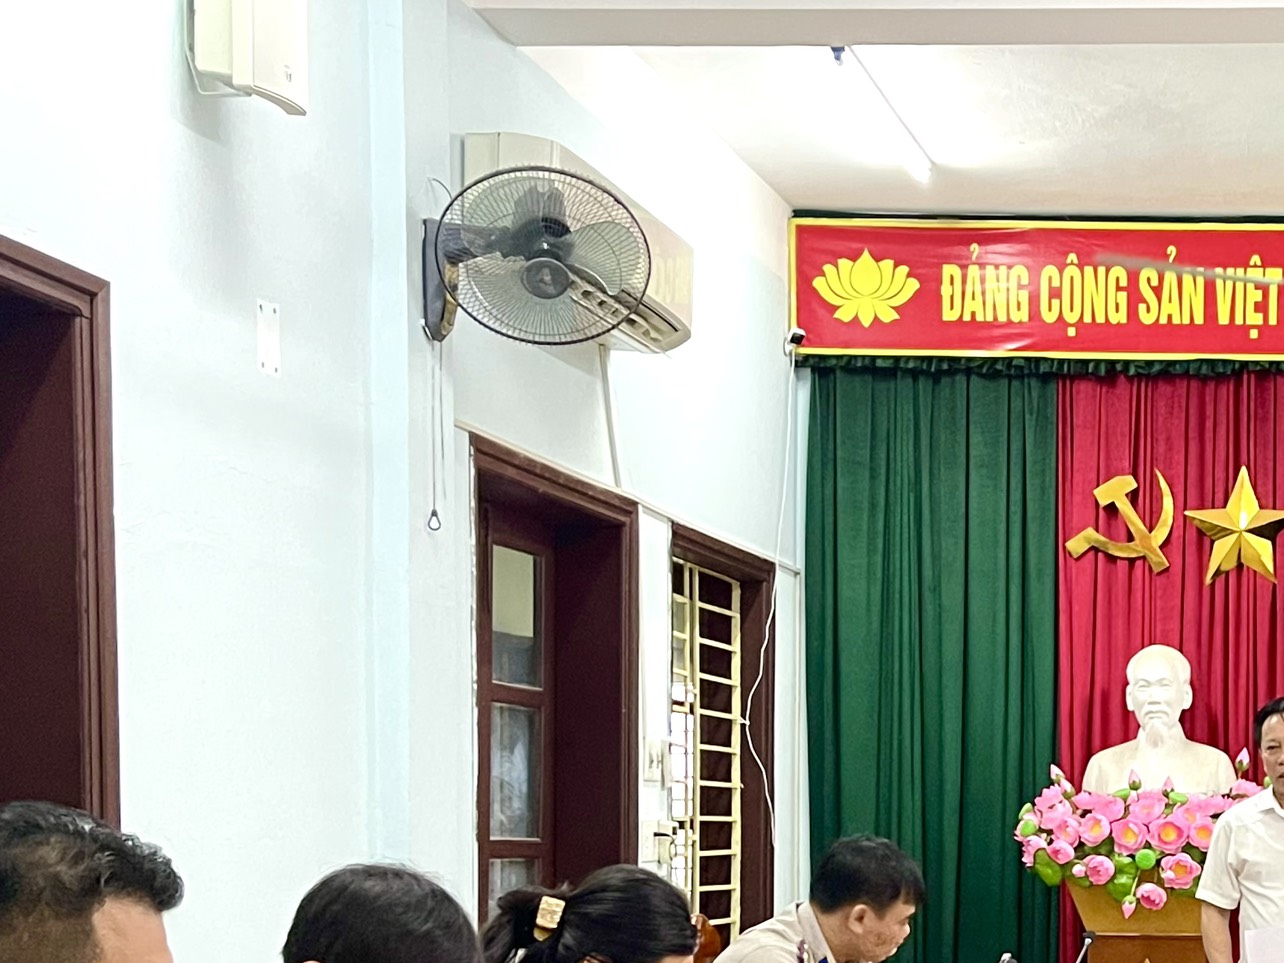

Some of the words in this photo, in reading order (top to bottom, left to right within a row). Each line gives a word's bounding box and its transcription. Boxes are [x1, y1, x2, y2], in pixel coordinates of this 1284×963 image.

[941, 243, 1030, 323] ĐẢNG
[1040, 253, 1128, 337] CỘNG
[1138, 245, 1205, 325] SẢN
[1216, 254, 1284, 339] VIỆT
